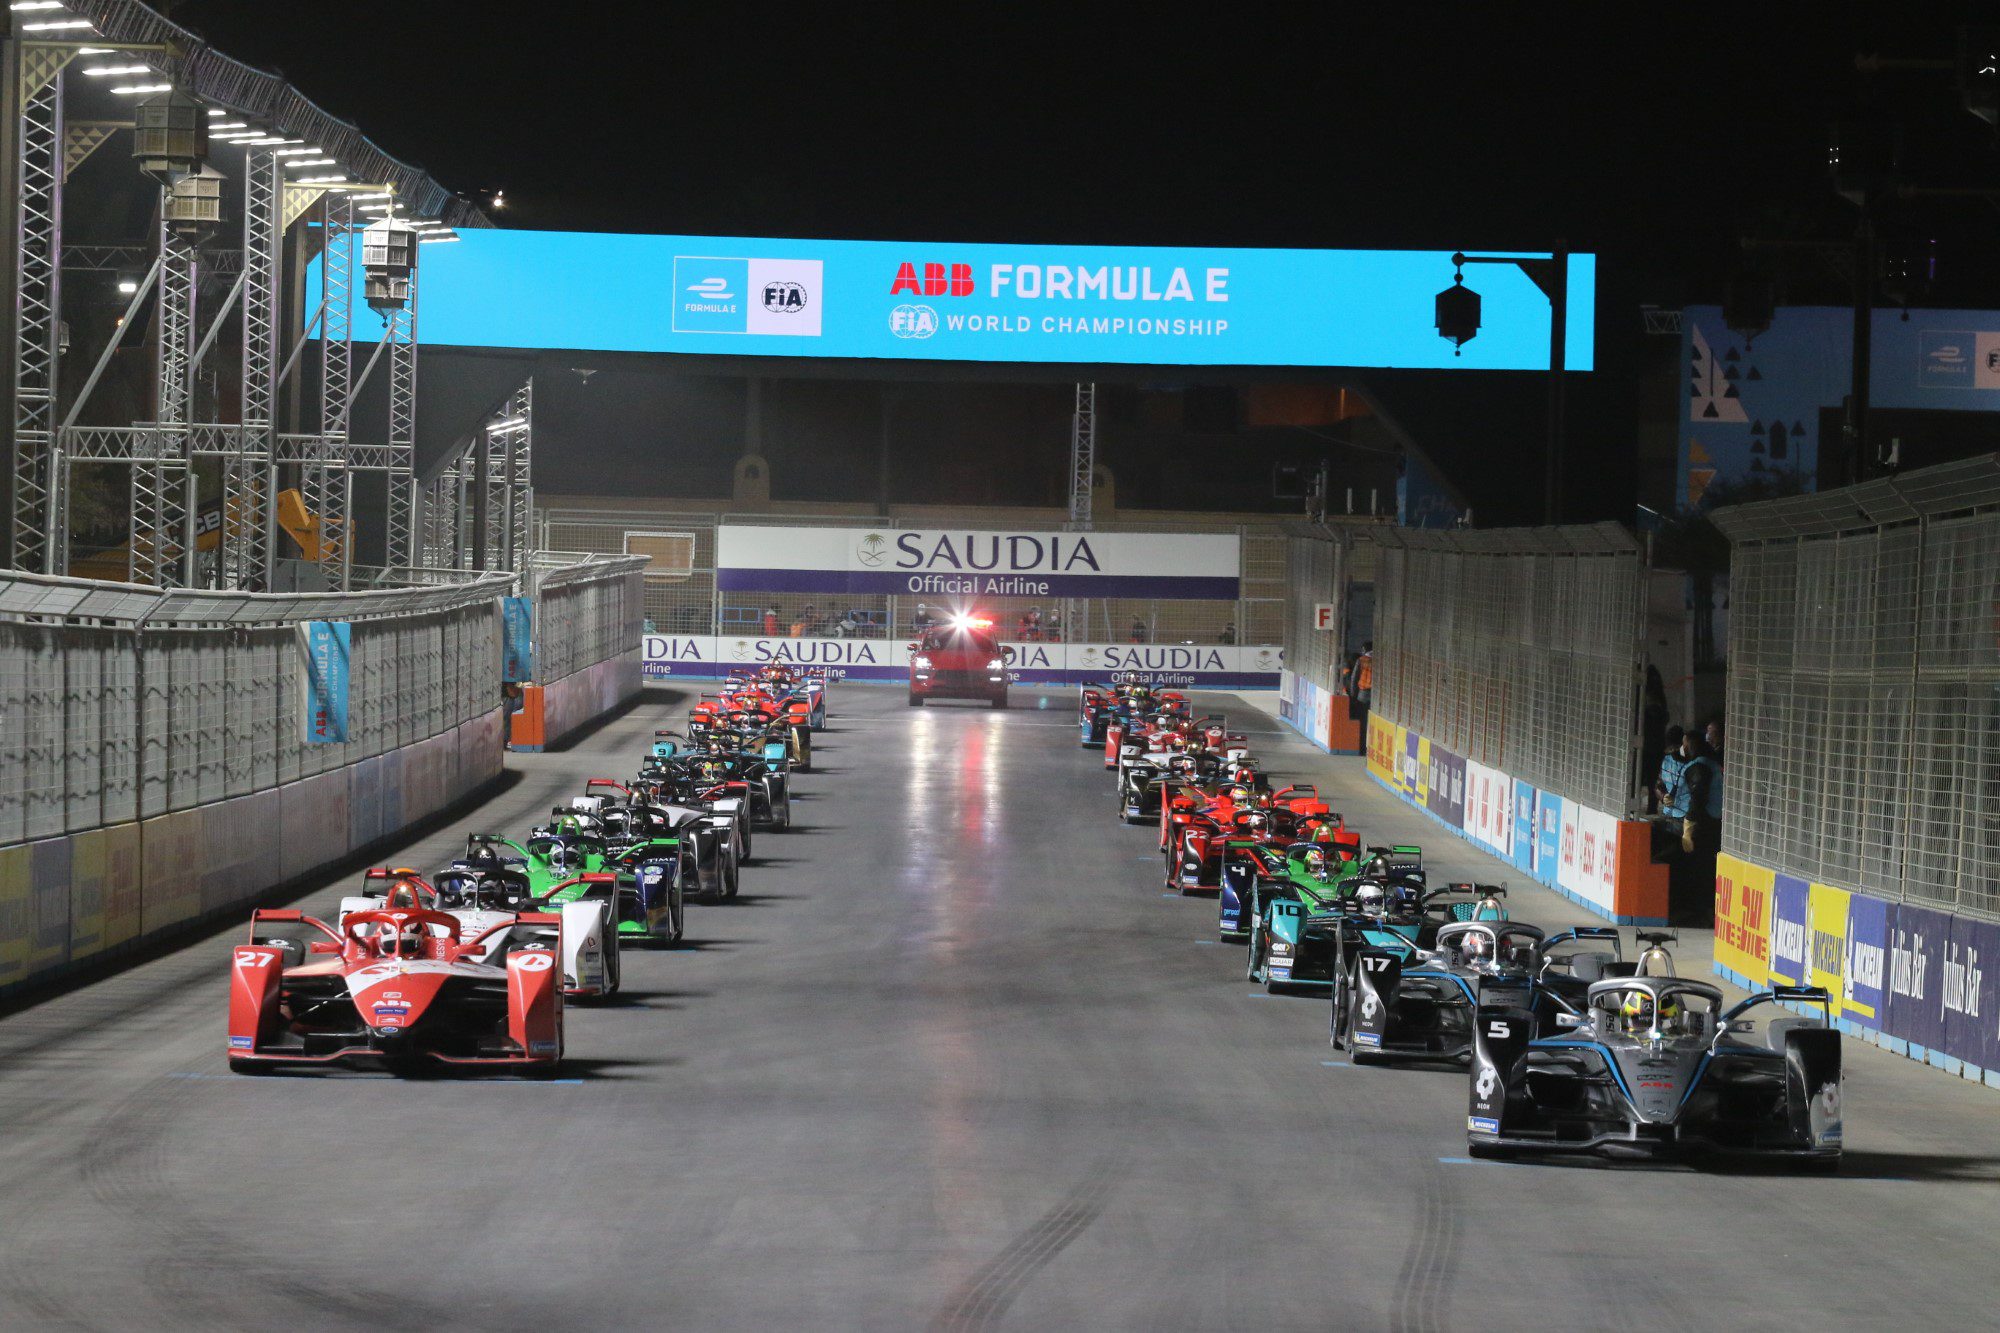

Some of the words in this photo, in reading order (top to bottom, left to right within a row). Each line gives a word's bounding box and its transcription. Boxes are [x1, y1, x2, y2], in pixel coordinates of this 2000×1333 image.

[889, 262, 975, 297] ABB
[990, 263, 1195, 302] FORMULA
[1205, 267, 1230, 302] E
[685, 303, 729, 313] FORMULA
[730, 304, 737, 313] E
[947, 314, 1031, 333] WORLD
[1041, 317, 1229, 336] CHAMPIONSHIP
[895, 532, 1101, 572] SAUDIA
[908, 576, 978, 594] Official
[984, 577, 1049, 595] Airline
[1319, 608, 1331, 627] F
[645, 638, 702, 660] DIA
[754, 640, 877, 664] SAUDIA
[1103, 646, 1225, 670] SAUDIA
[642, 662, 671, 674] irline
[1156, 673, 1195, 684] Airline
[315, 710, 328, 737] ABB
[1231, 866, 1246, 877] 4
[1275, 904, 1301, 916] 10
[237, 951, 275, 968] 27
[1362, 957, 1392, 972] 17
[1888, 928, 1912, 1007] Julius
[1940, 940, 1965, 1023] Julius
[1487, 1021, 1511, 1039] 5
